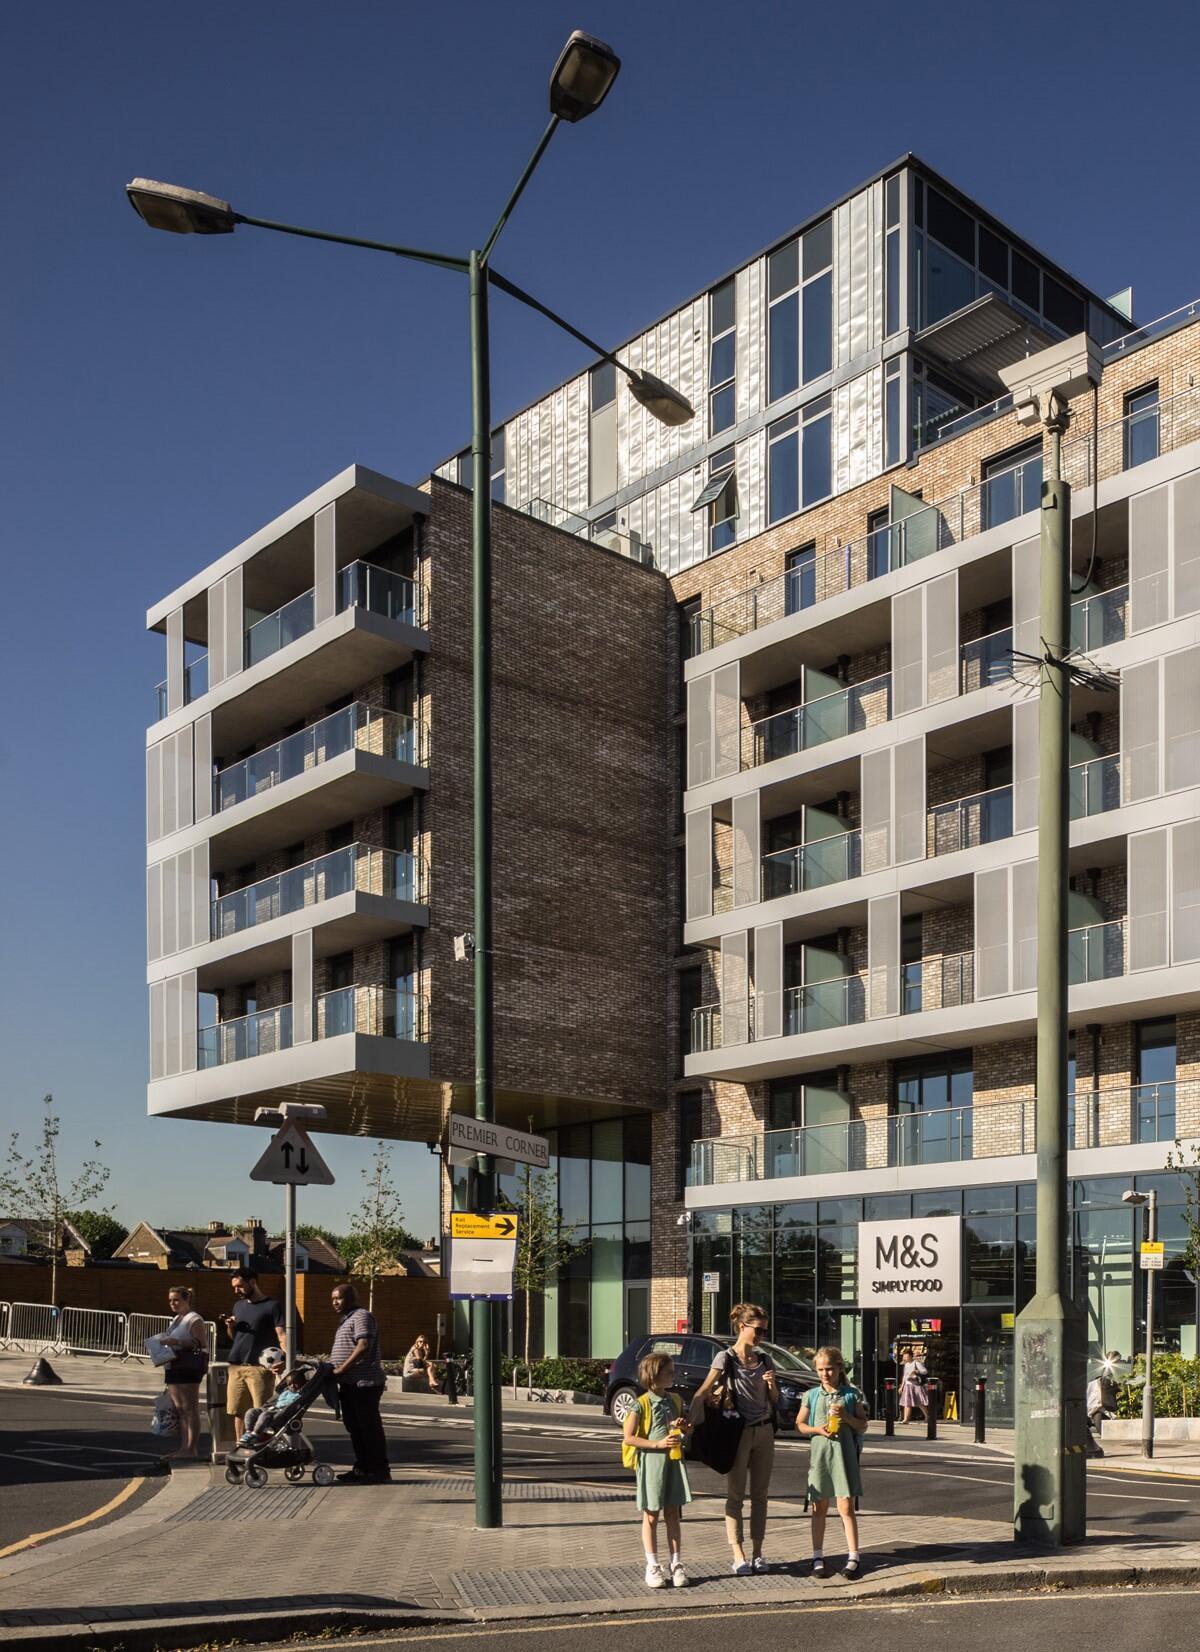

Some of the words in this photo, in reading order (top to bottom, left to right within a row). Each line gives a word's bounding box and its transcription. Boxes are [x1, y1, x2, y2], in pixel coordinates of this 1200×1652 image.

[452, 1121, 498, 1147] PREMIER
[505, 1136, 547, 1159] CORNER
[875, 1232, 939, 1270] M&S
[872, 1280, 909, 1293] SIMPLY
[910, 1279, 943, 1292] FOOD
